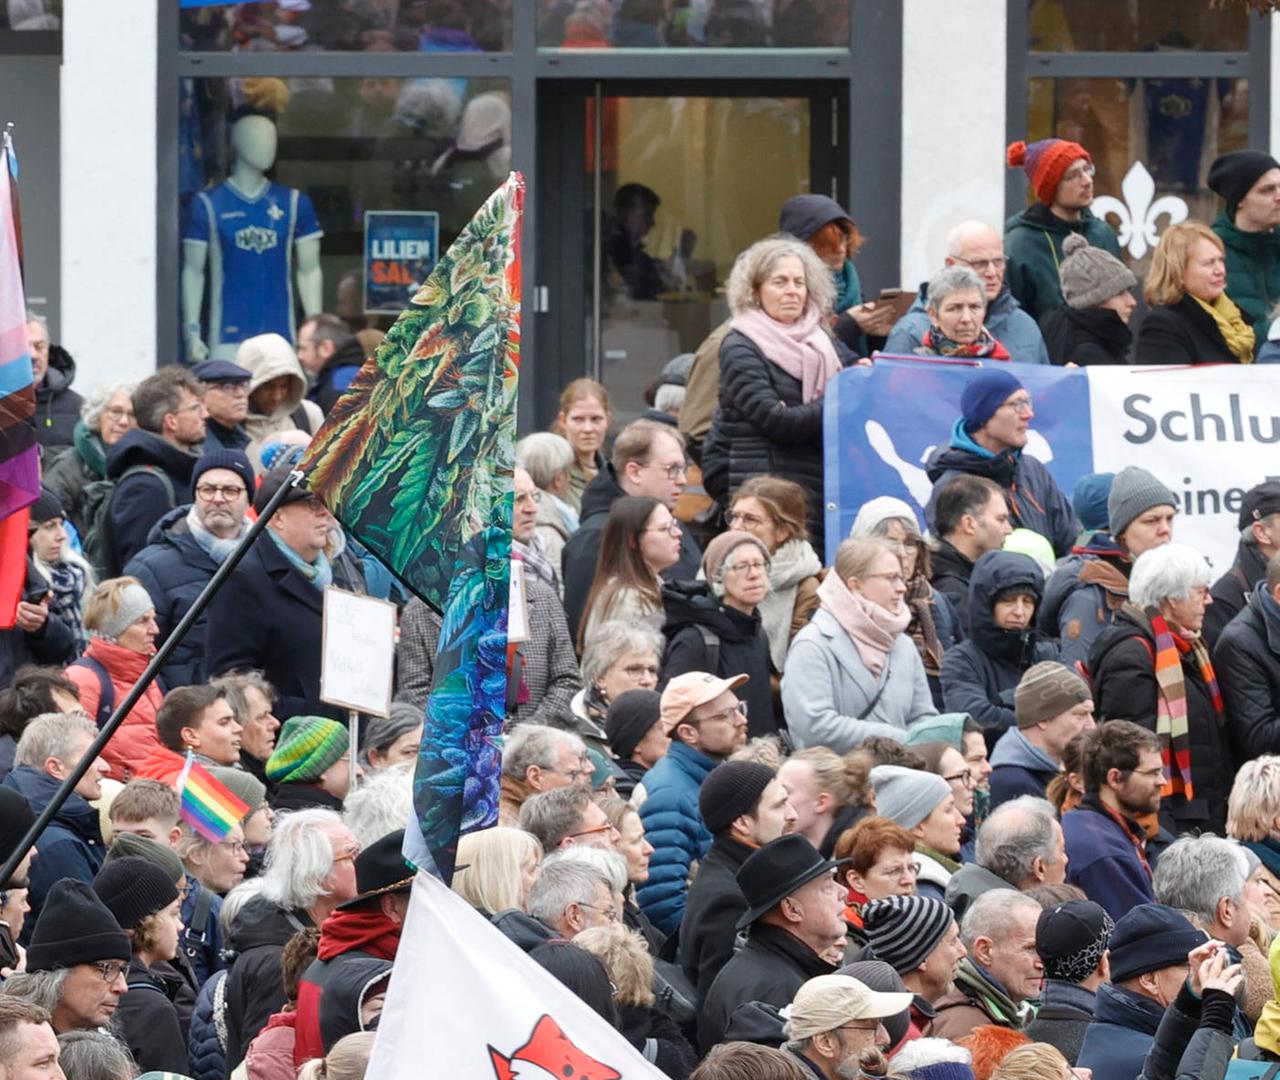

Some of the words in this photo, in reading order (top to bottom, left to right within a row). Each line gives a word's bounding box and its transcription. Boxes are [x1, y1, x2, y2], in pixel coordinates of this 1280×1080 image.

[371, 239, 430, 260] LILIEN
[371, 261, 414, 285] SAL
[1122, 393, 1280, 445] Schlu
